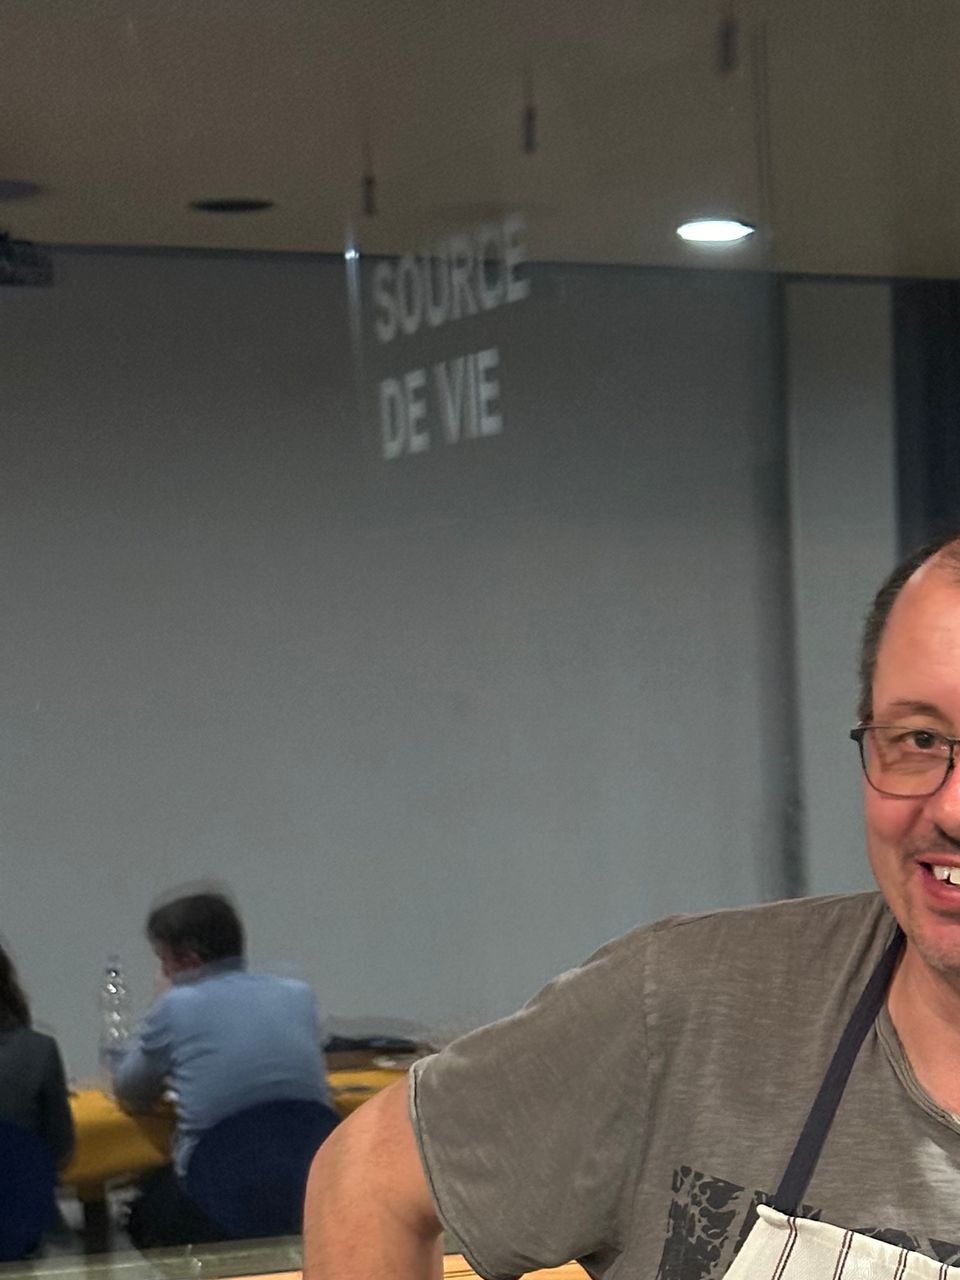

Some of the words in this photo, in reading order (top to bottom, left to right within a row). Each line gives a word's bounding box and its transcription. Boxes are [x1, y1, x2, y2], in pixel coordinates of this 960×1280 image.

[374, 214, 530, 343] SOURCE
[379, 370, 431, 460] DE
[434, 349, 503, 444] VIE
